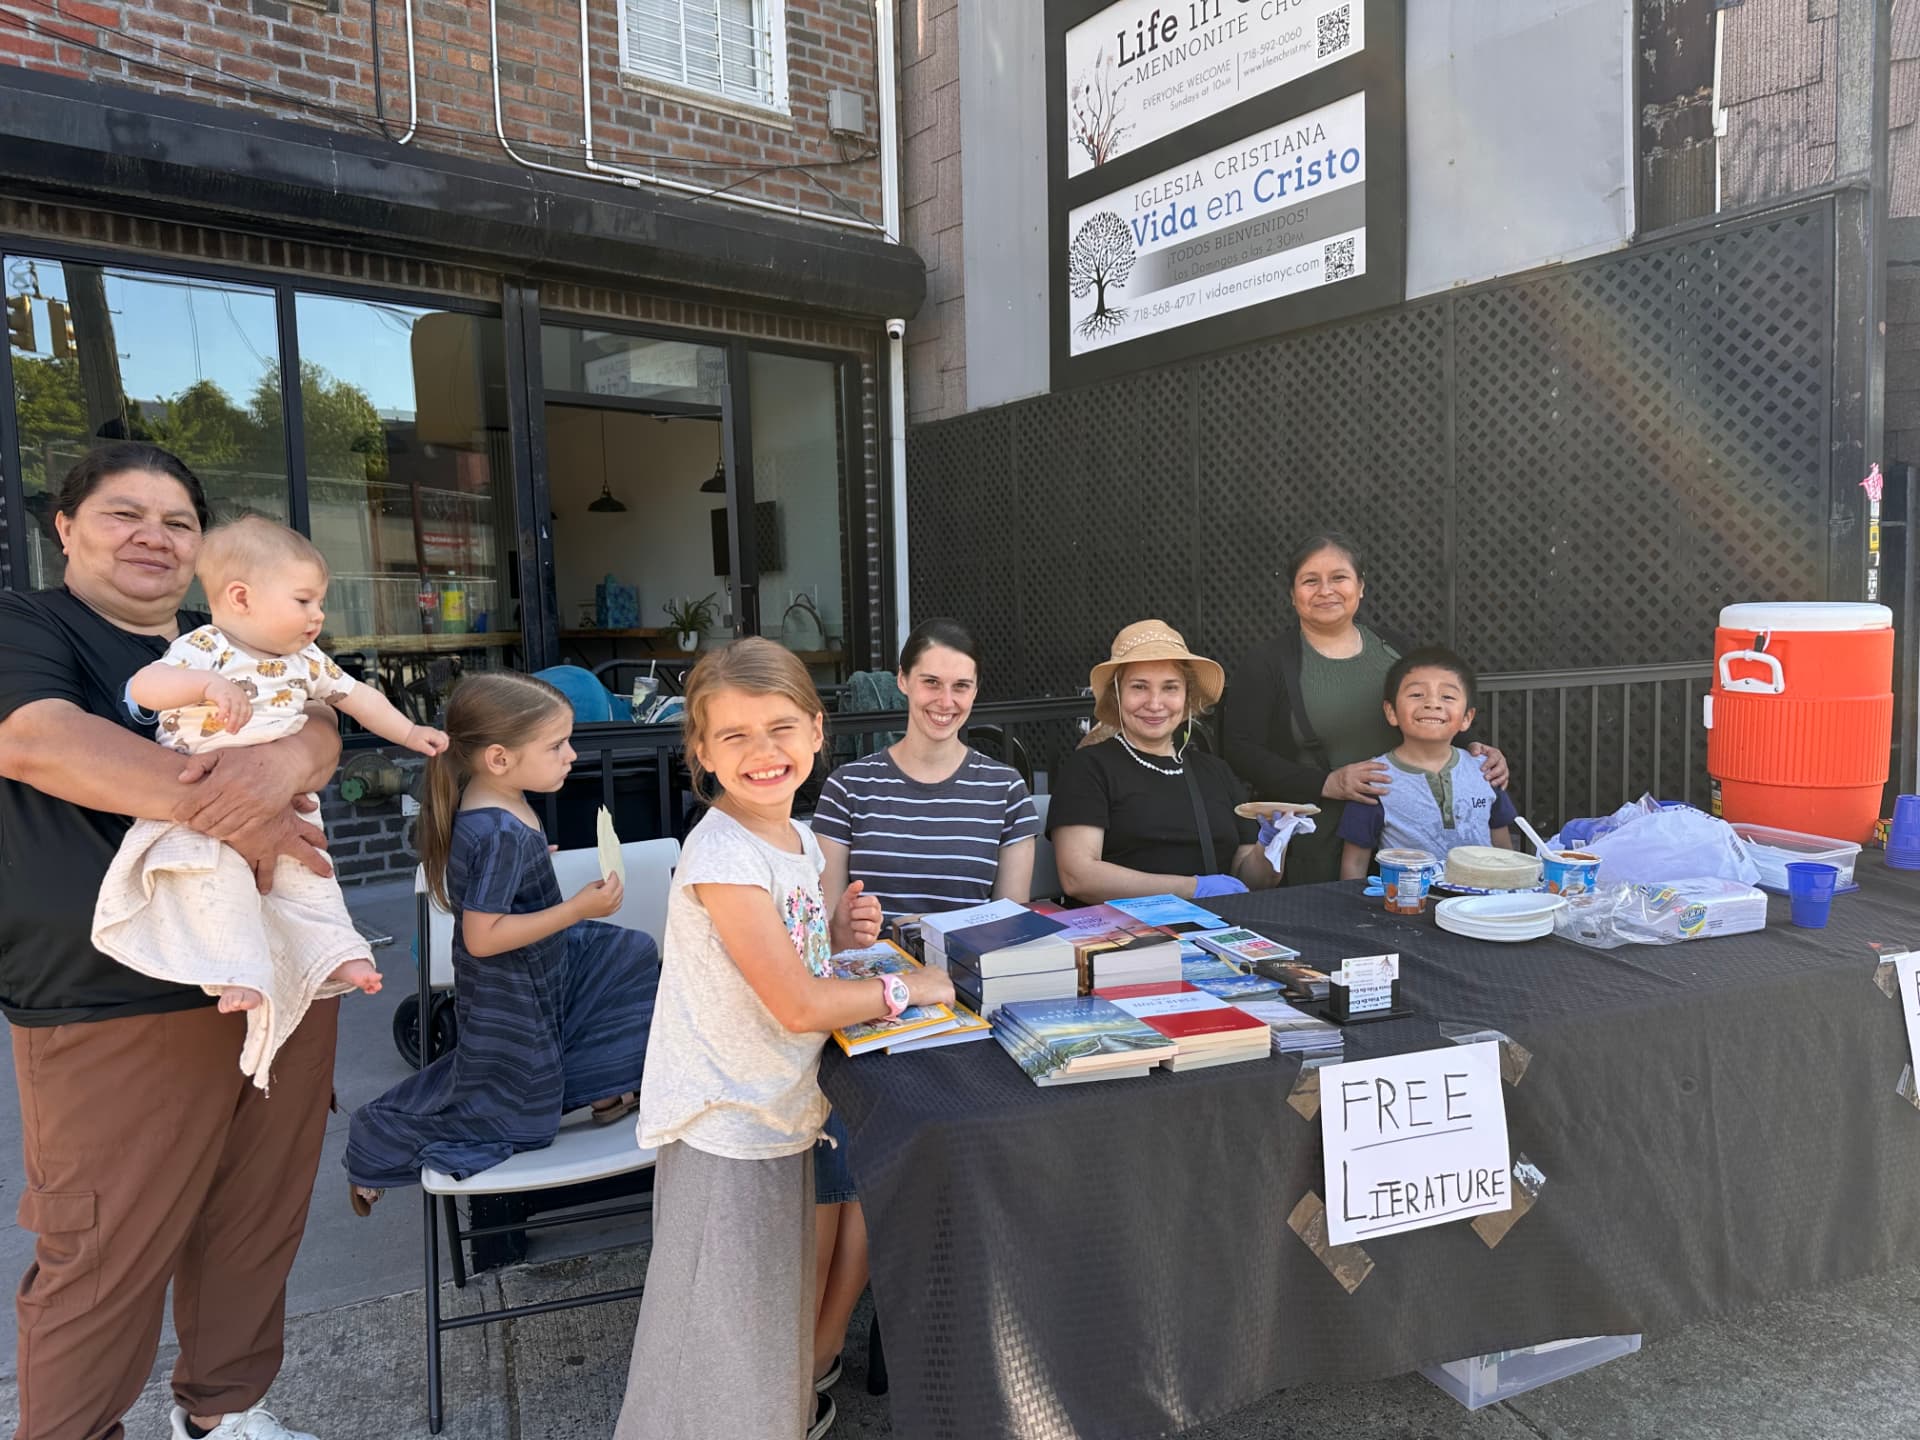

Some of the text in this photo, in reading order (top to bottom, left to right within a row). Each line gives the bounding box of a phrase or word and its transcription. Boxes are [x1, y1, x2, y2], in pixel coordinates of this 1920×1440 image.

[1117, 8, 1178, 68] Life
[1136, 12, 1248, 84] MENNONITE
[1143, 59, 1231, 110] EVERYONE WELCOME
[1131, 148, 1360, 247] Vida en Cristo
[1135, 123, 1326, 211] IGLESIA CRISTIANA
[1215, 208, 1309, 250] BIENVENIDOS!
[1134, 258, 1319, 322] 718-568-4717 vidaencristonyc.com
[1341, 1073, 1472, 1134] FREE
[1342, 1160, 1505, 1222] LITERATURE
